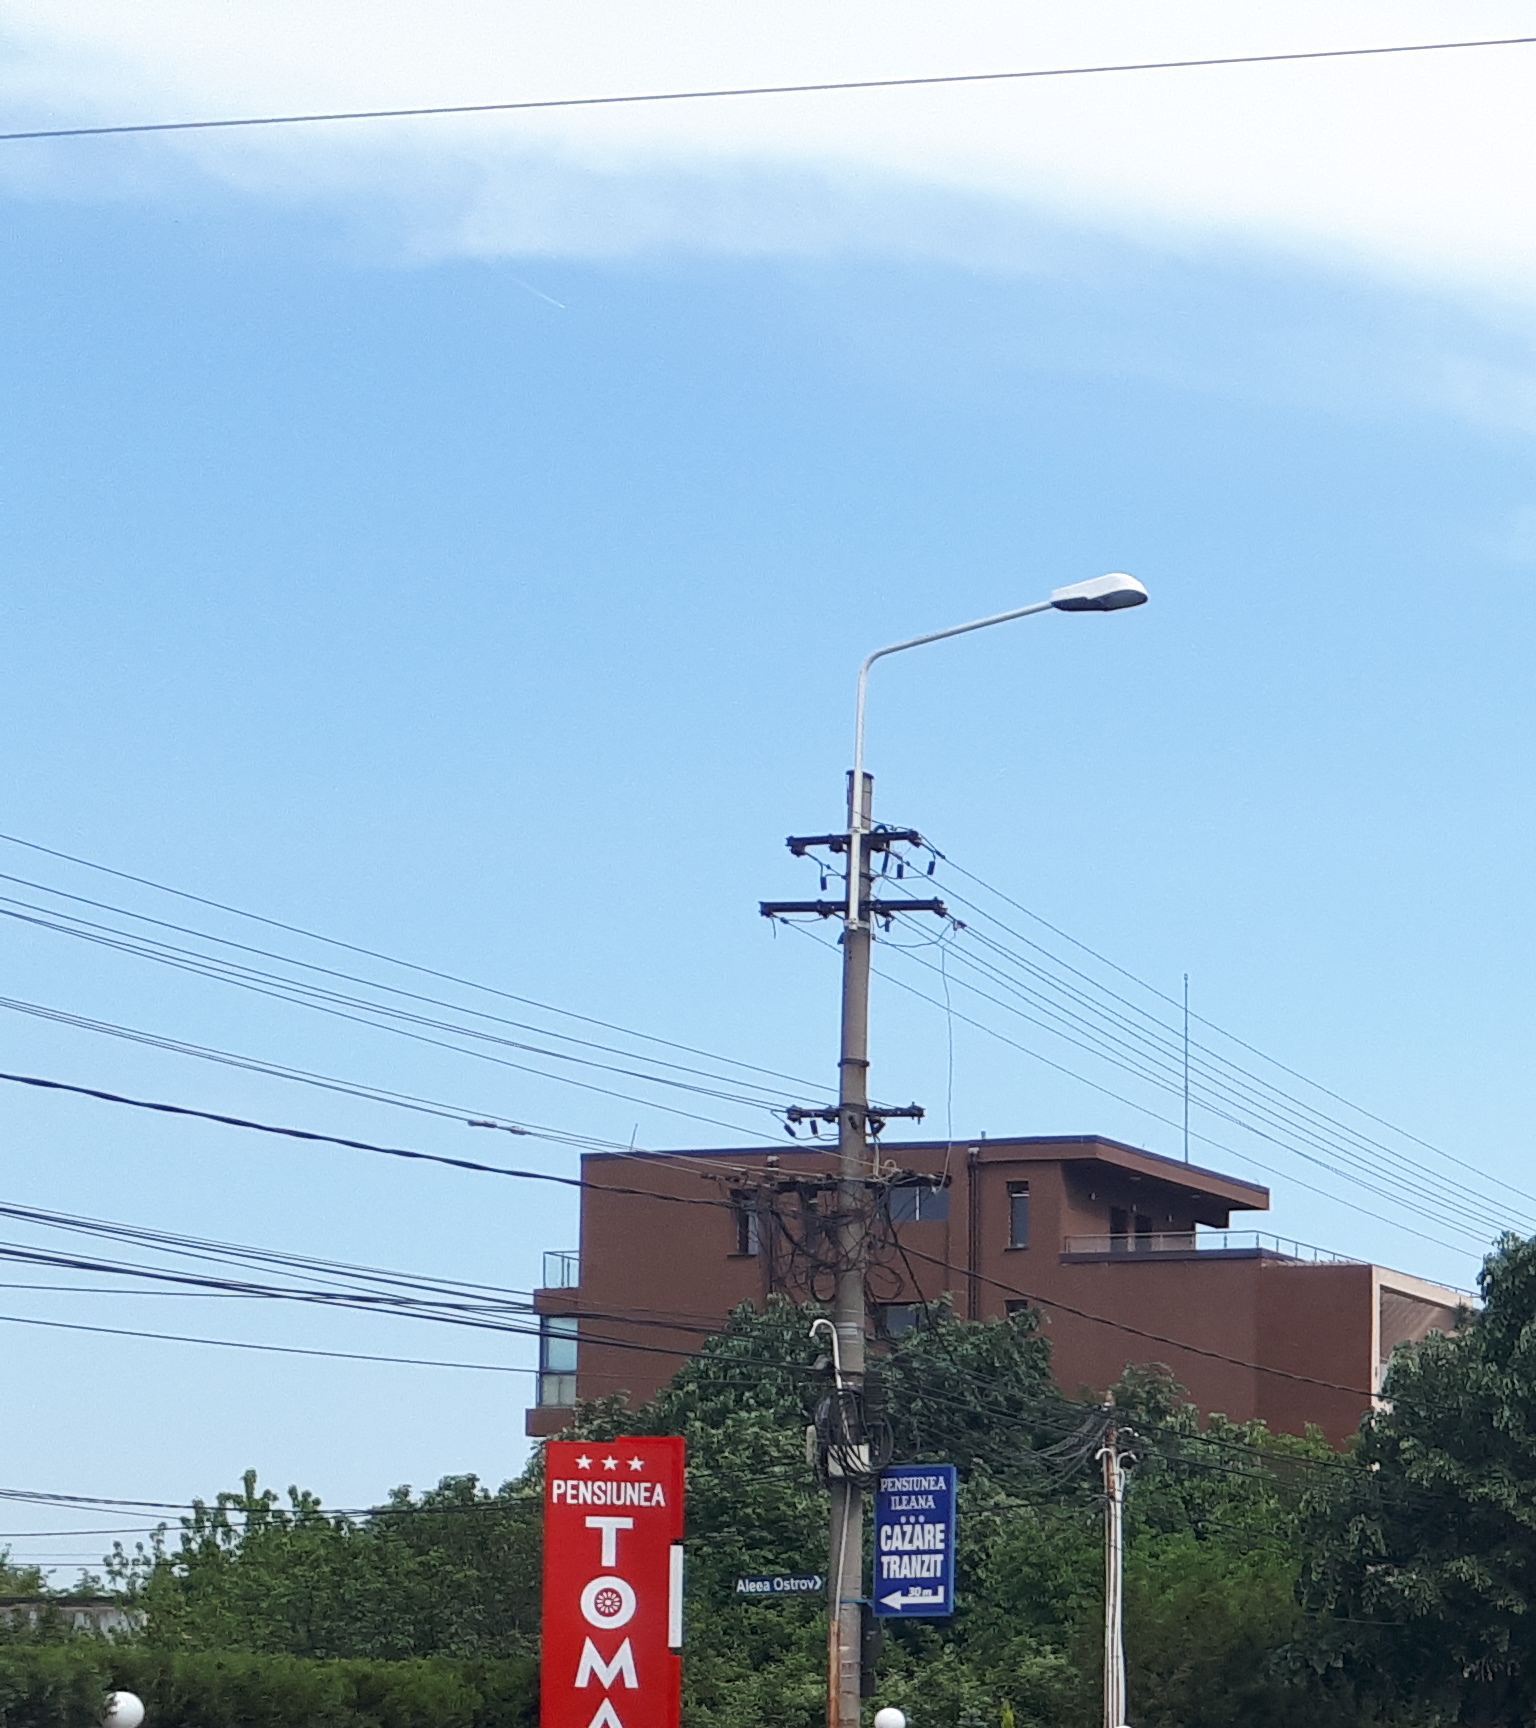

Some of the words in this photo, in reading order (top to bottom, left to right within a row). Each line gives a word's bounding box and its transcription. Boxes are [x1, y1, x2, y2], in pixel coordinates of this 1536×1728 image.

[552, 1479, 667, 1508] PENSIUNEA
[880, 1476, 947, 1492] PENSIUNEA
[890, 1495, 936, 1511] ILEANA
[880, 1523, 946, 1551] CAZARE
[880, 1553, 944, 1579] TRANZIT
[736, 1579, 771, 1593] Aleea
[773, 1576, 815, 1591] Ostrov
